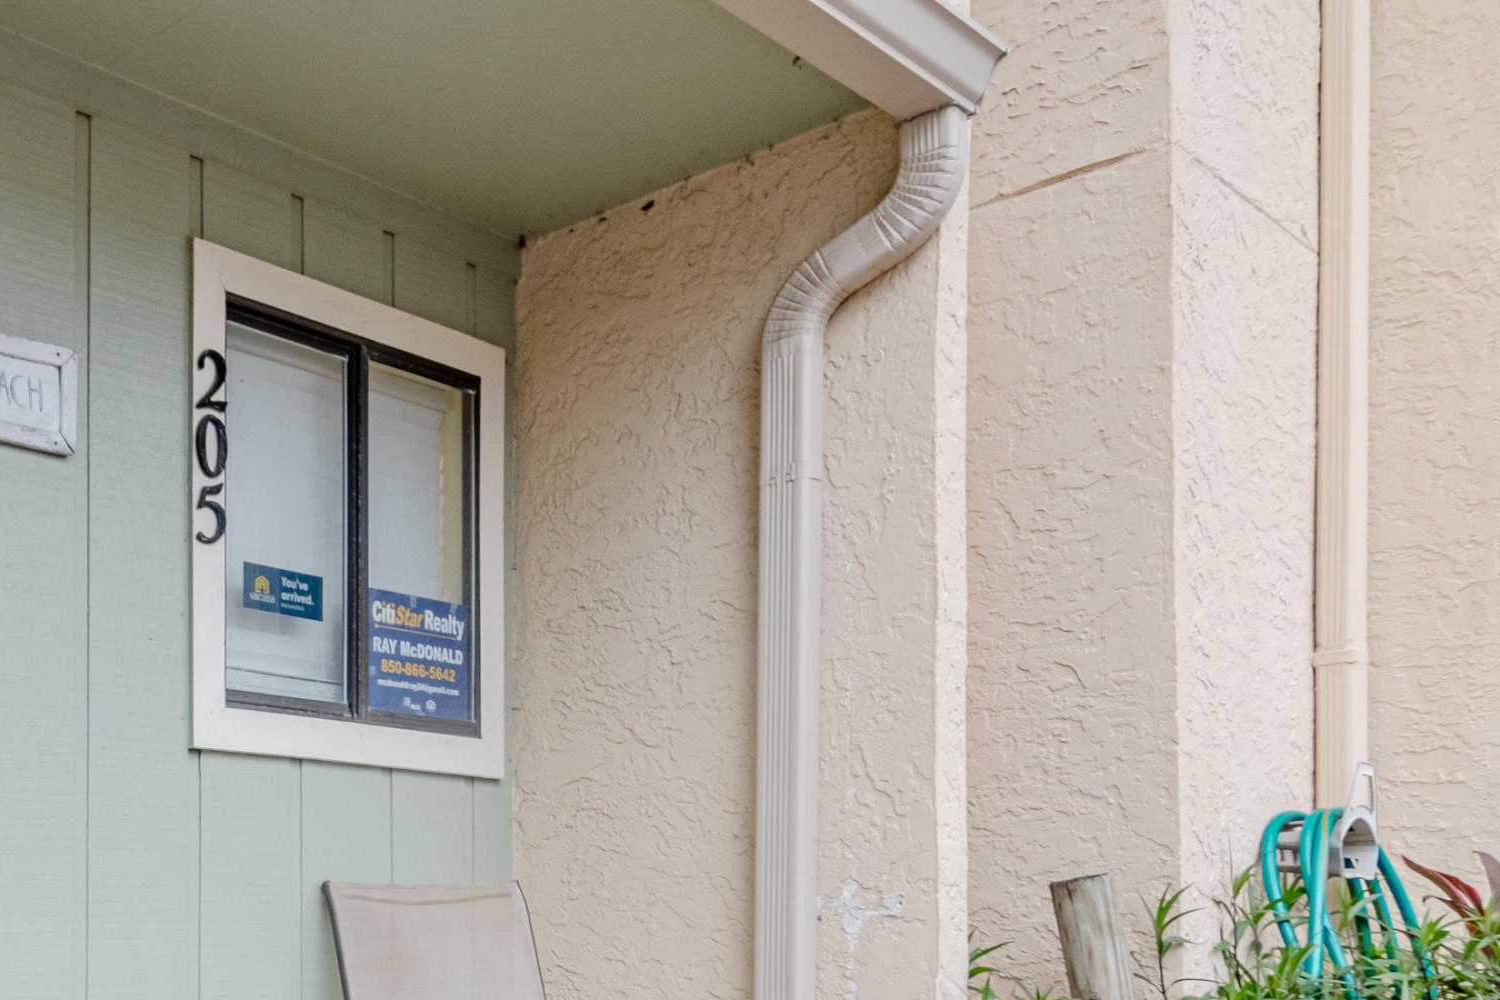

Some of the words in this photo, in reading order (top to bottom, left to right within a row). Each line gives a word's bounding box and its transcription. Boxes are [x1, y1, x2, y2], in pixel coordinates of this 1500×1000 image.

[195, 349, 228, 545] 205
[372, 600, 424, 628] CitiStar
[424, 609, 465, 641] Realty
[372, 635, 398, 655] RAY
[400, 640, 464, 666] McDONALD
[381, 658, 456, 683] 850-866-5642
